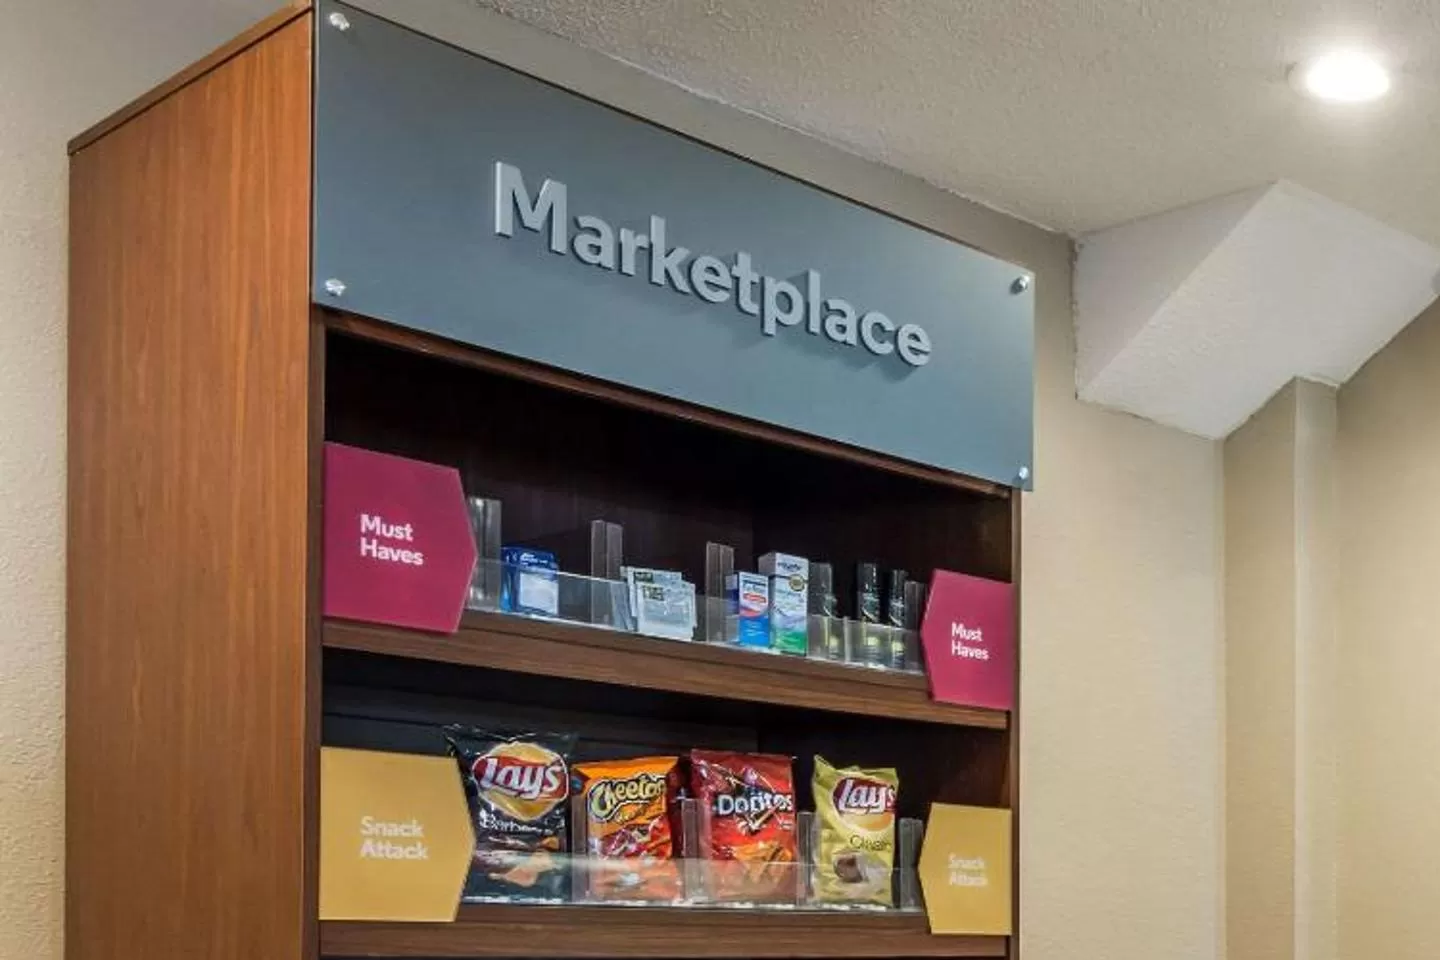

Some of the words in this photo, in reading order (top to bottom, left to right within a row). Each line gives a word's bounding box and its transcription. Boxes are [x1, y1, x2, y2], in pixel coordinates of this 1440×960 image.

[494, 160, 932, 367] Marketplace
[360, 513, 413, 542] Must
[360, 537, 424, 566] Haves
[951, 622, 982, 642] Must
[951, 640, 990, 660] Haves
[361, 816, 425, 837] Snack
[360, 839, 428, 860] Attack
[948, 853, 985, 869] Snack
[950, 871, 988, 886] Attack
